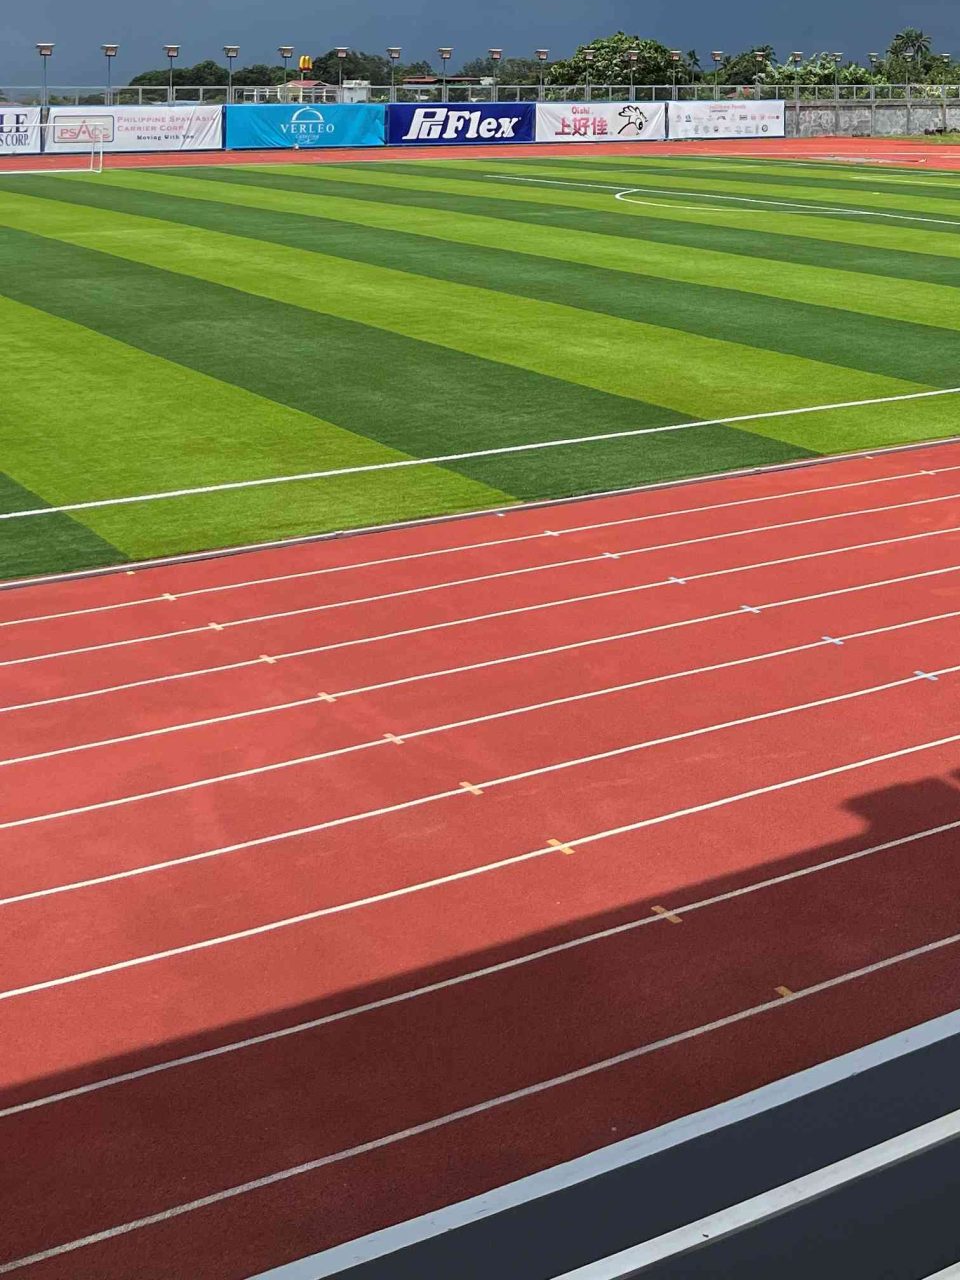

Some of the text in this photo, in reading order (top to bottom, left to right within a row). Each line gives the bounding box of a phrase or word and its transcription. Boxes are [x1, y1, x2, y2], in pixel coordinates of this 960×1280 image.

[571, 106, 591, 115] Oishi
[280, 123, 335, 134] VERLEO
[554, 117, 609, 136] 上好佳
